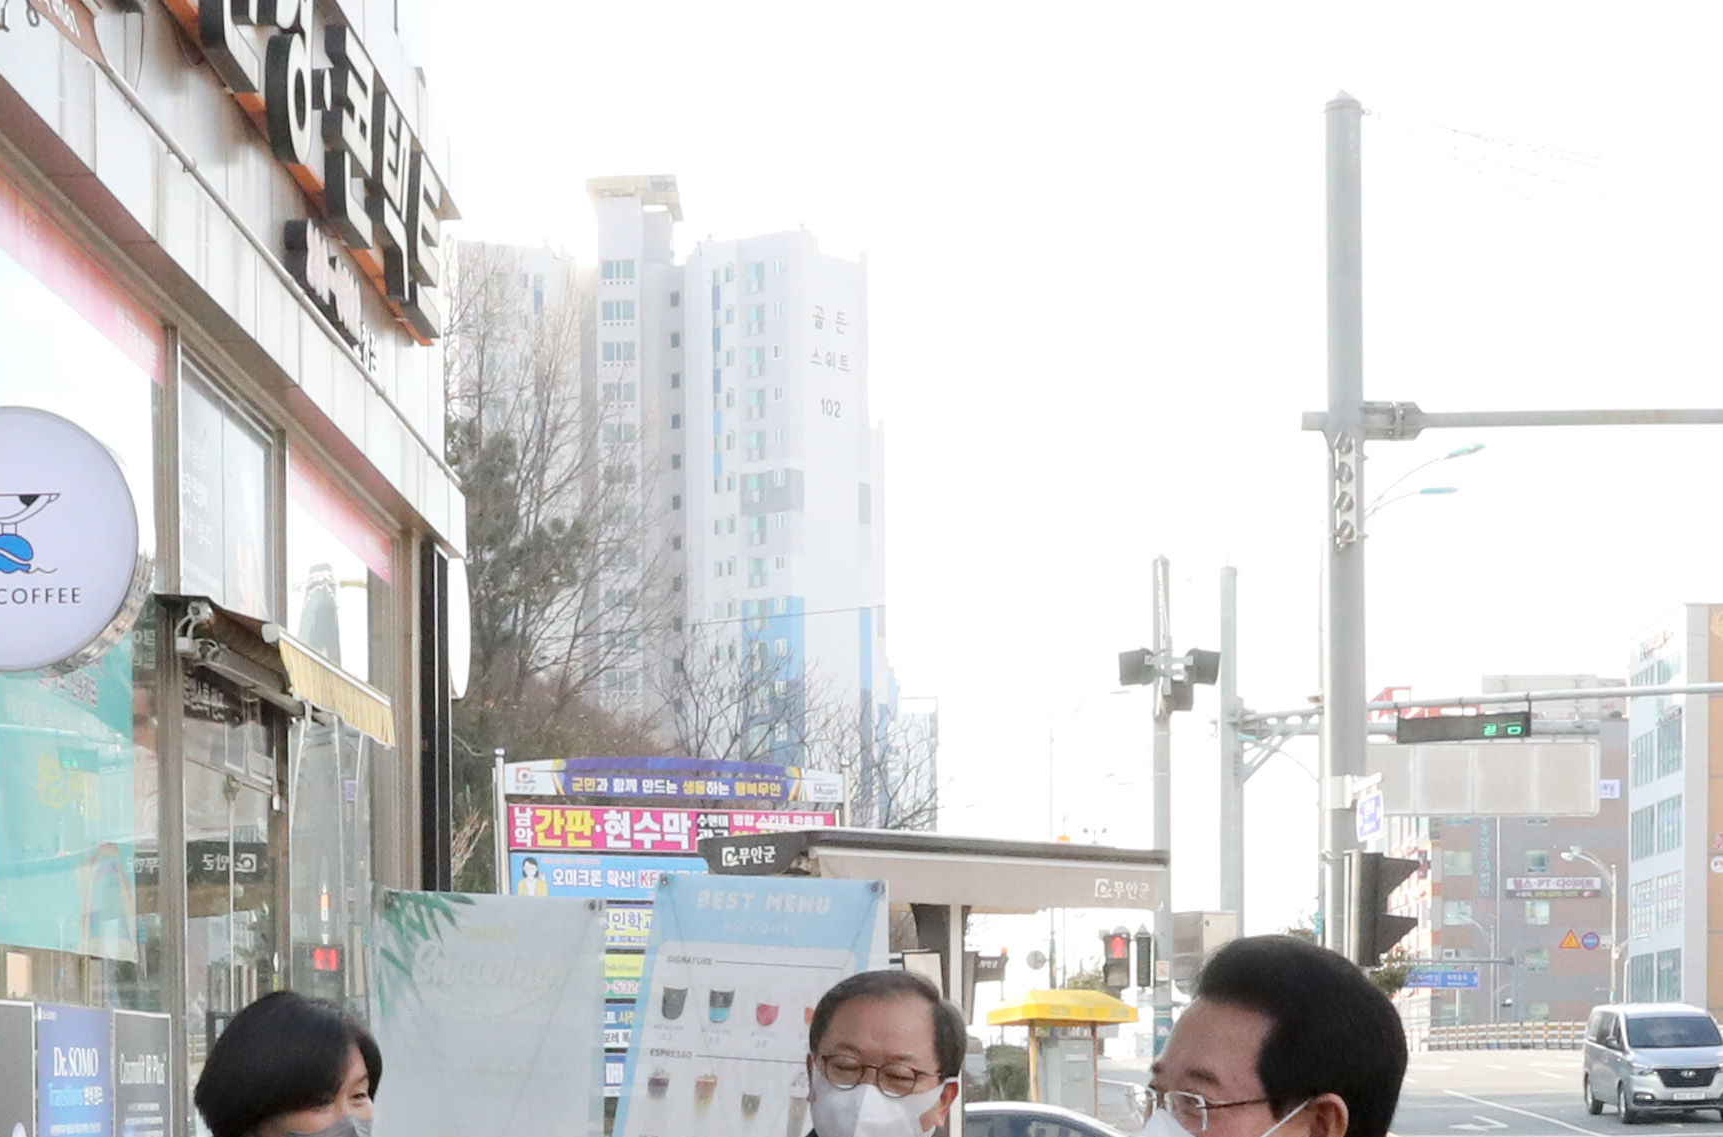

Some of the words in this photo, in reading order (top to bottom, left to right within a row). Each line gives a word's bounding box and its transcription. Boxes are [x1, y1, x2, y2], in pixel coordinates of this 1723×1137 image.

[820, 397, 841, 418] 102
[572, 777, 608, 792] 군민과
[613, 778, 638, 792] 함께
[642, 779, 678, 795] 만드는
[514, 807, 533, 847] 남악
[739, 846, 776, 865] 무안군
[552, 868, 603, 887] 오미크론
[607, 869, 636, 888] 확산!
[1113, 881, 1150, 900] 무안군
[697, 889, 755, 911] BEST
[766, 893, 833, 914] MENU
[667, 955, 713, 966] SIGNATURE
[650, 1049, 692, 1060] ESPRESSO
